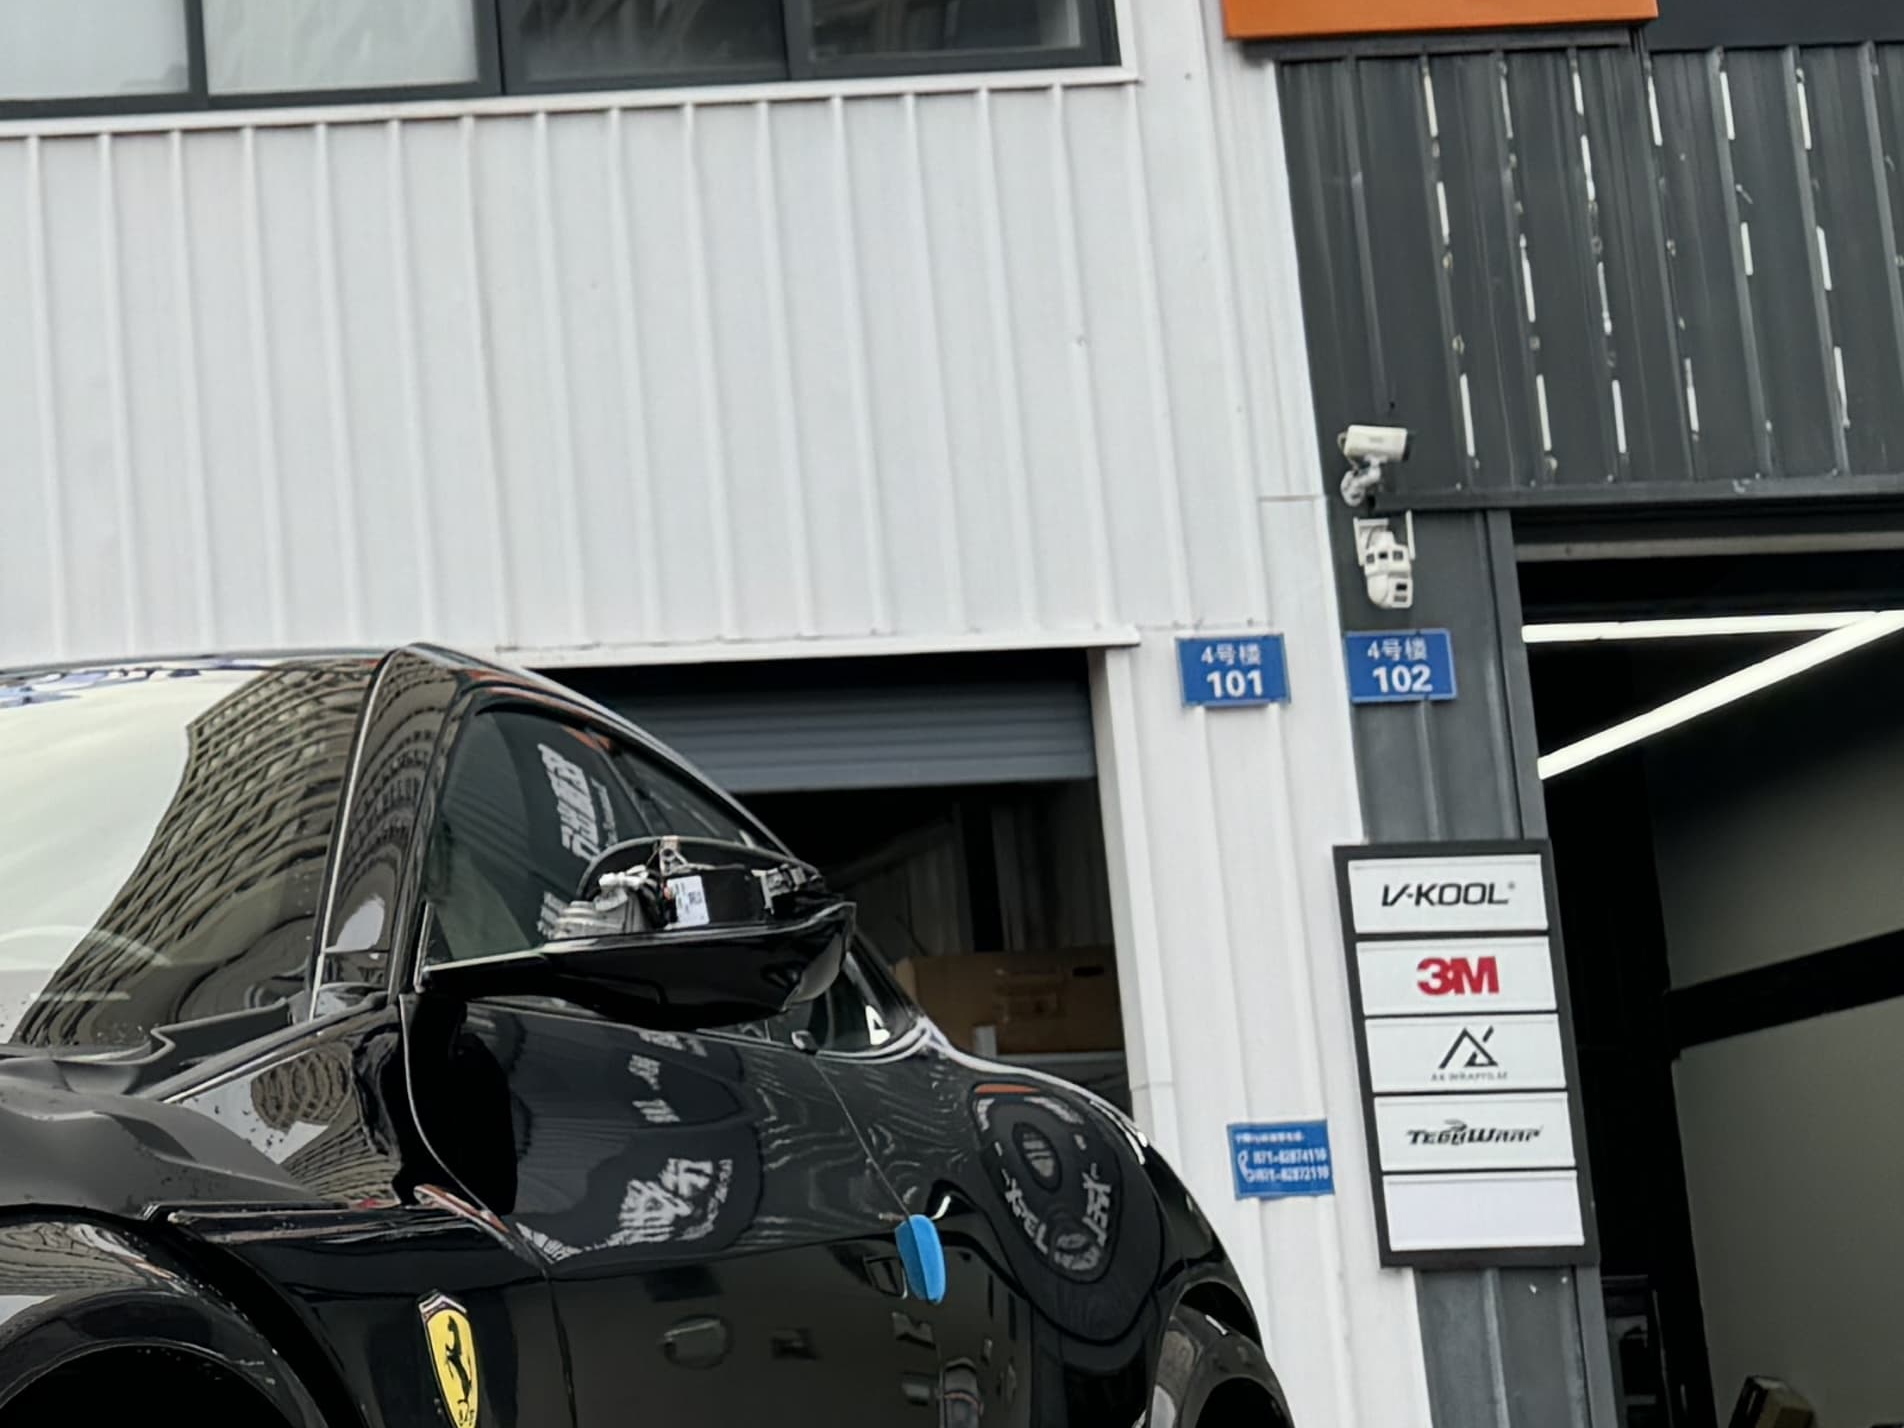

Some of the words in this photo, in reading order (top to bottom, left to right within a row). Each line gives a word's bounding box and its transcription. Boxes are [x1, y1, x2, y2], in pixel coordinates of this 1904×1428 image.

[1201, 642, 1261, 666] 4号楼
[1367, 637, 1428, 661] 4号楼
[1206, 669, 1263, 698] 101
[1372, 664, 1433, 693] 102
[1417, 955, 1500, 996] 3M
